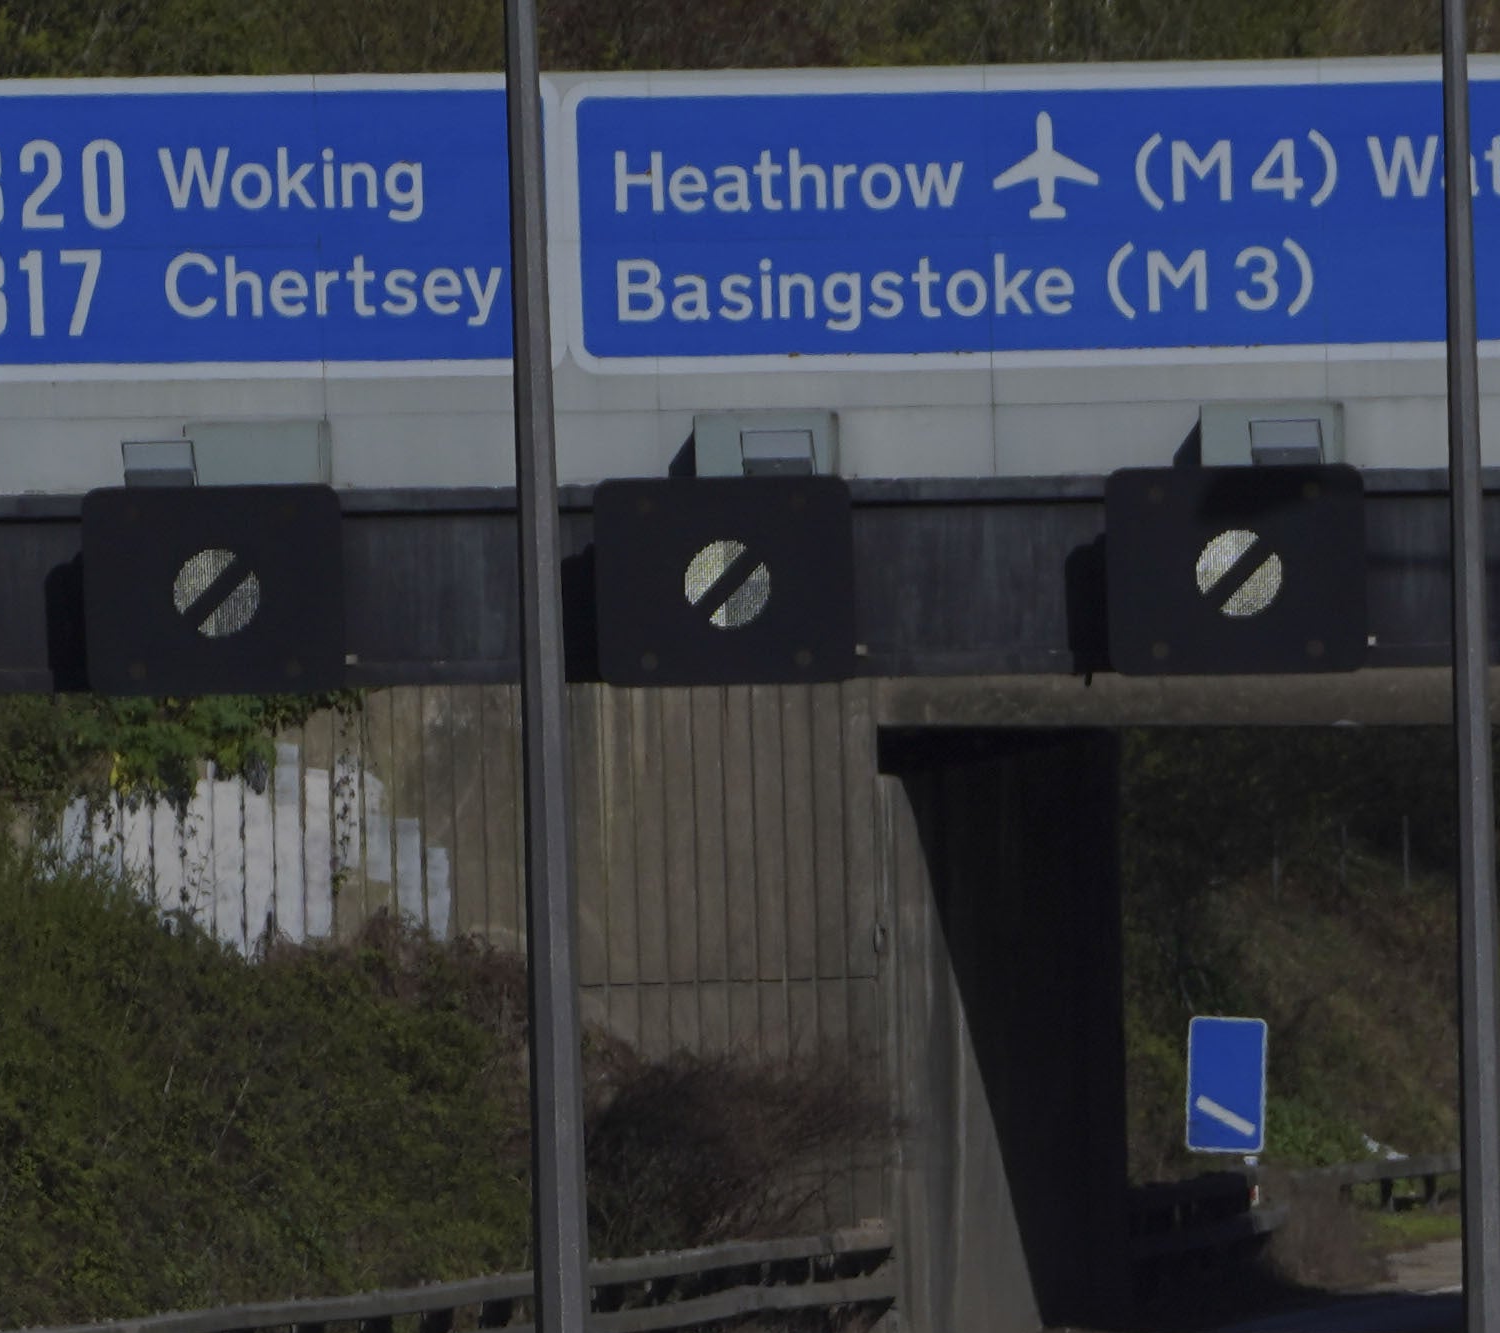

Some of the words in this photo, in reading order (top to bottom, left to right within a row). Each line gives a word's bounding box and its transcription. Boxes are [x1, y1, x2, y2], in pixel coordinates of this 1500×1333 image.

[159, 148, 424, 222] Woking
[614, 148, 964, 212] Heathrow
[1136, 132, 1338, 210] (M4)
[165, 253, 504, 327] Chertsey
[617, 253, 1076, 333] Basingstoke
[1107, 238, 1313, 320] (M3)
